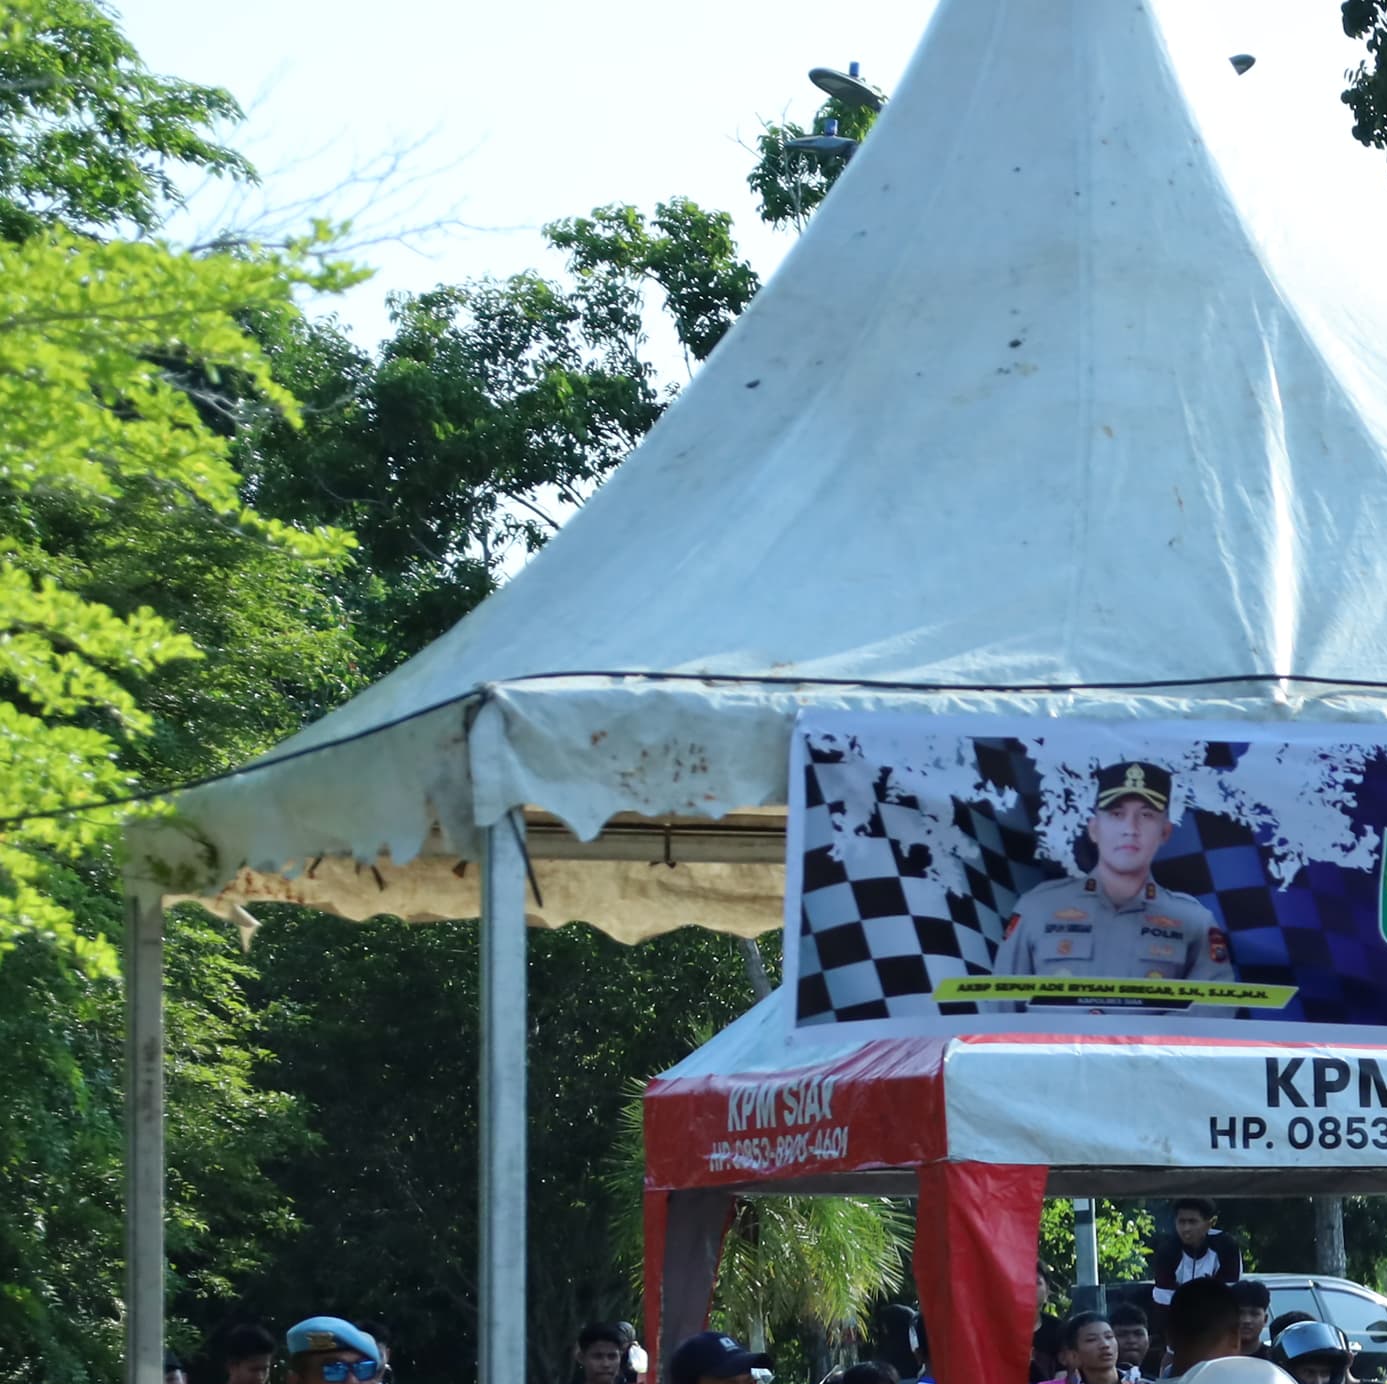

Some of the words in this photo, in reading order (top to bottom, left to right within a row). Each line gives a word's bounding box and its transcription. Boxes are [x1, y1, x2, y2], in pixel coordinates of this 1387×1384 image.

[727, 1082, 777, 1132] KPM
[782, 1075, 835, 1126] SIAK
[1209, 1116, 1275, 1150] HP.
[709, 1141, 732, 1172] HP.
